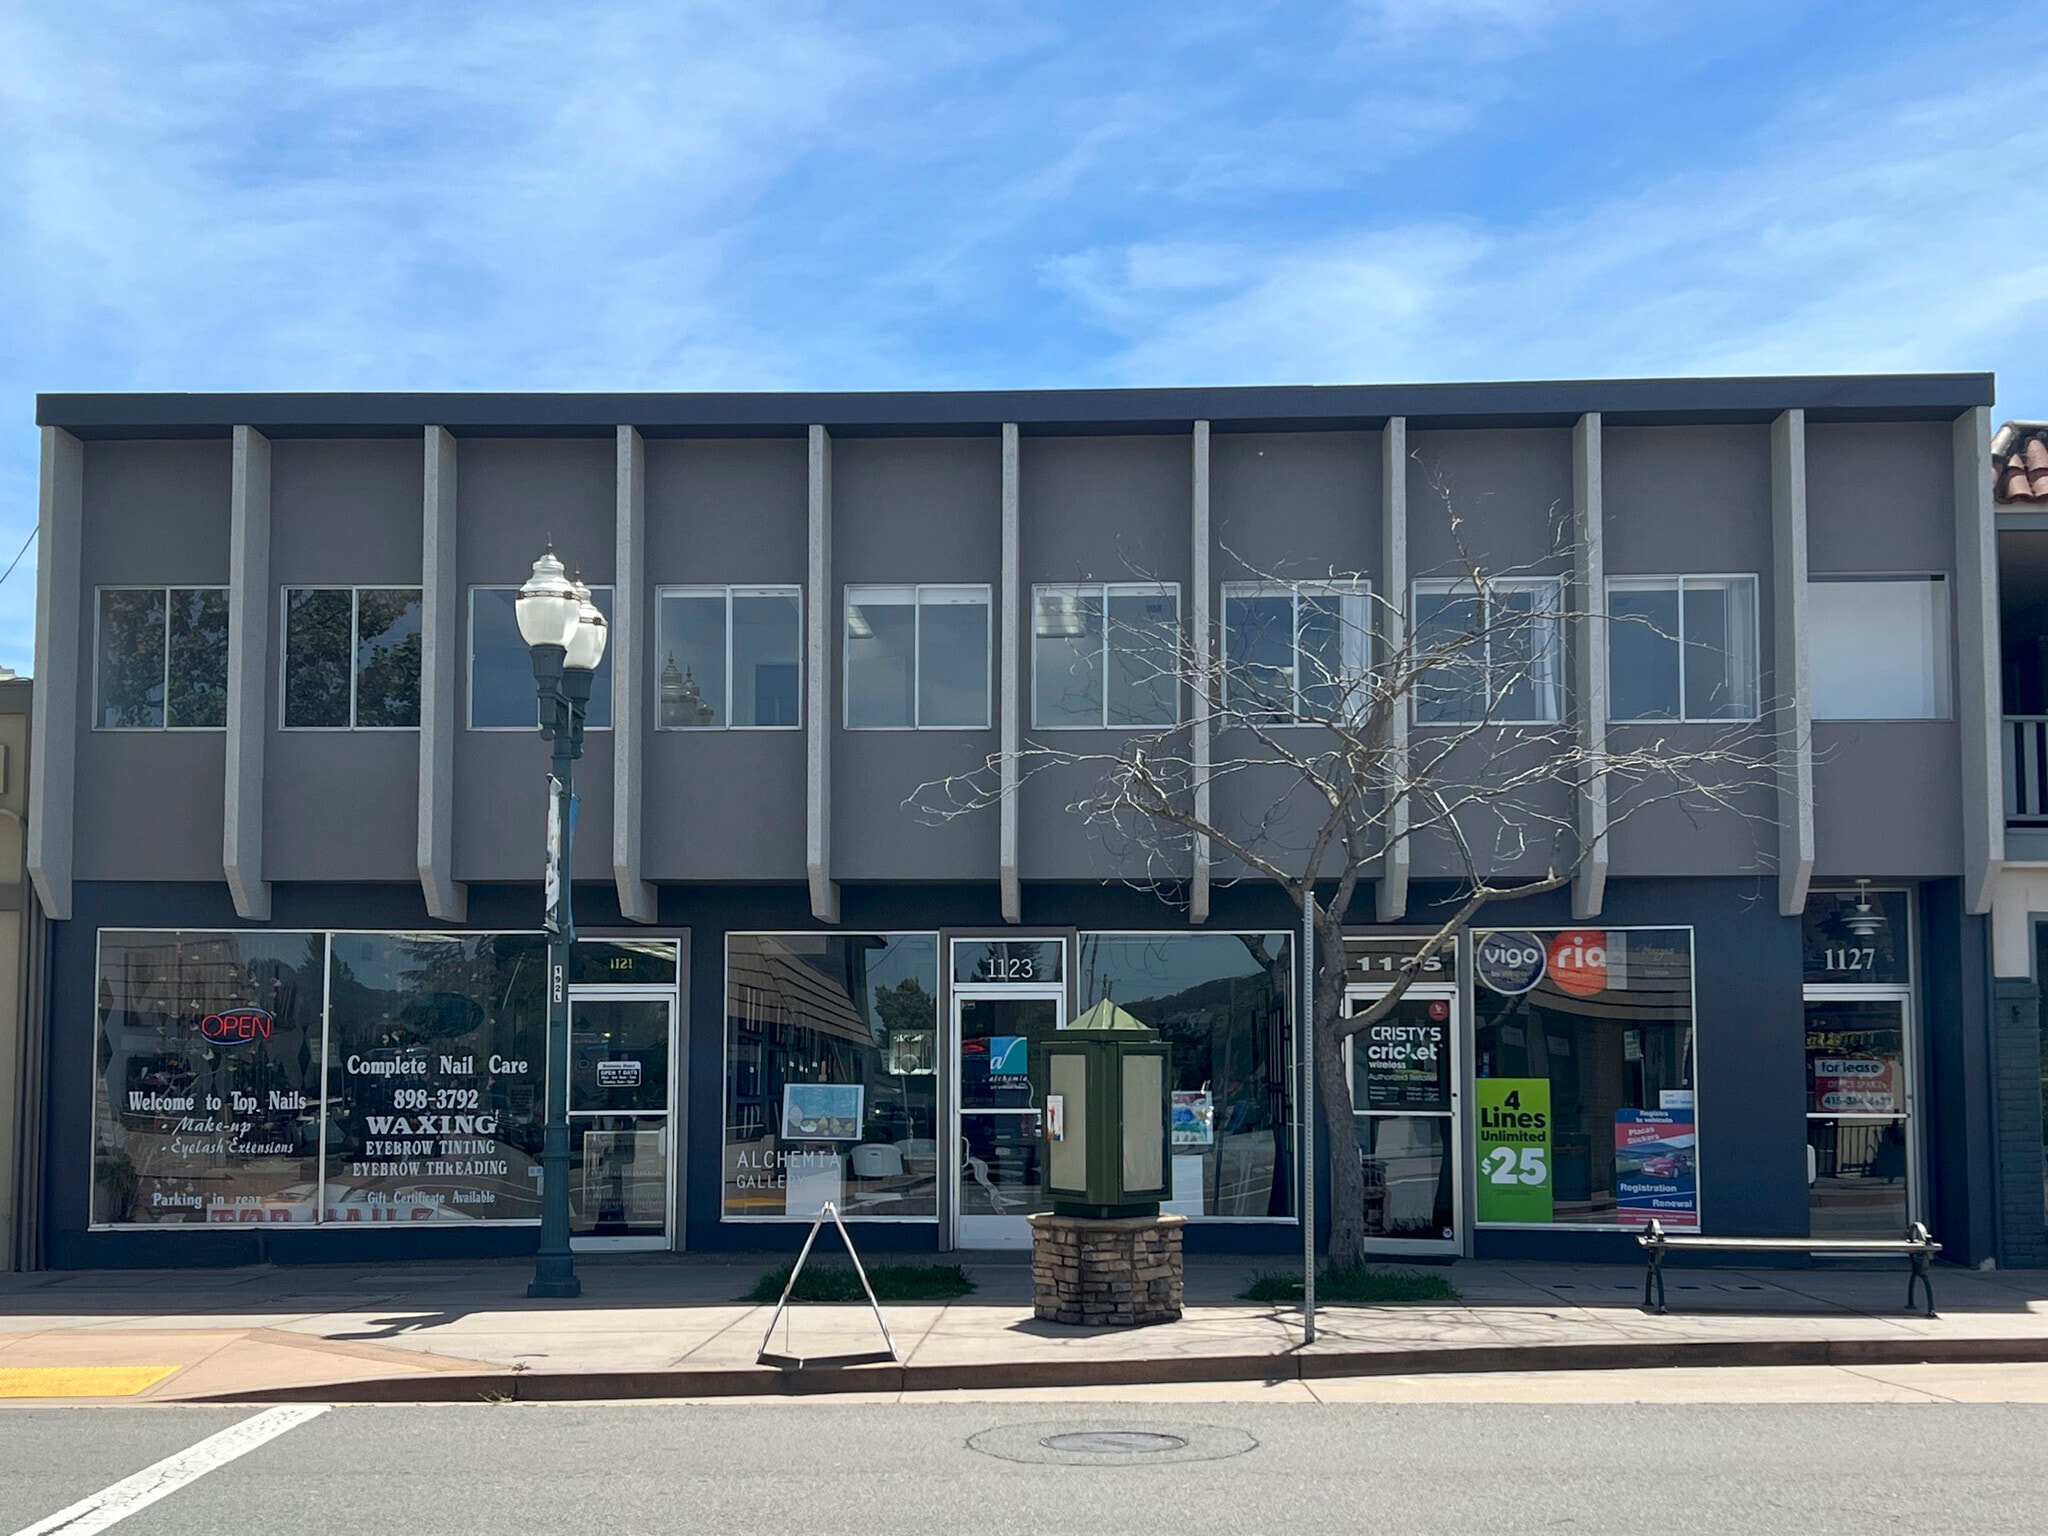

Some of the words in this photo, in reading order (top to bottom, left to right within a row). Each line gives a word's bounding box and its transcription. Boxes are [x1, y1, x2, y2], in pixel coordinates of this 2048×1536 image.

[1485, 943, 1538, 968] vigo
[1558, 936, 1607, 968] ria
[1824, 948, 1875, 970] 1127
[610, 957, 633, 969] 1121
[987, 958, 1034, 979] 1123
[201, 1015, 271, 1038] OPEN
[1371, 1026, 1442, 1041] CRISTY'S
[1368, 1043, 1438, 1060] cricket
[347, 1054, 427, 1078] Complete
[440, 1055, 474, 1075] Nail
[488, 1054, 528, 1074] Care
[1368, 1061, 1406, 1069] wireless
[1843, 1061, 1880, 1073] lease
[128, 1091, 195, 1111] Welcome
[205, 1093, 222, 1111] to
[230, 1091, 258, 1115] Top
[268, 1090, 307, 1111] Nails
[393, 1089, 479, 1110] 898-3792
[1504, 1090, 1521, 1111] 4
[171, 1116, 251, 1138] Make-up
[365, 1115, 499, 1135] WAXING
[1481, 1106, 1546, 1128] Lines
[1481, 1130, 1546, 1142] Unlimited
[171, 1137, 223, 1159] Eyelash
[228, 1137, 294, 1155] Extensions
[365, 1140, 434, 1156] EYEBROW
[438, 1139, 496, 1155] TINTING
[353, 1161, 421, 1177] EYEBROW
[425, 1160, 508, 1176] THREADING
[737, 1150, 841, 1169] ALCHEMIA
[1481, 1146, 1547, 1185] $25
[367, 1191, 387, 1204] Gift
[393, 1191, 445, 1204] Certificate
[452, 1190, 496, 1204] Available
[1620, 1183, 1677, 1193] Registration
[152, 1192, 203, 1209] Parking
[212, 1192, 225, 1206] in
[235, 1194, 262, 1205] rear
[1652, 1199, 1693, 1208] Renewal
